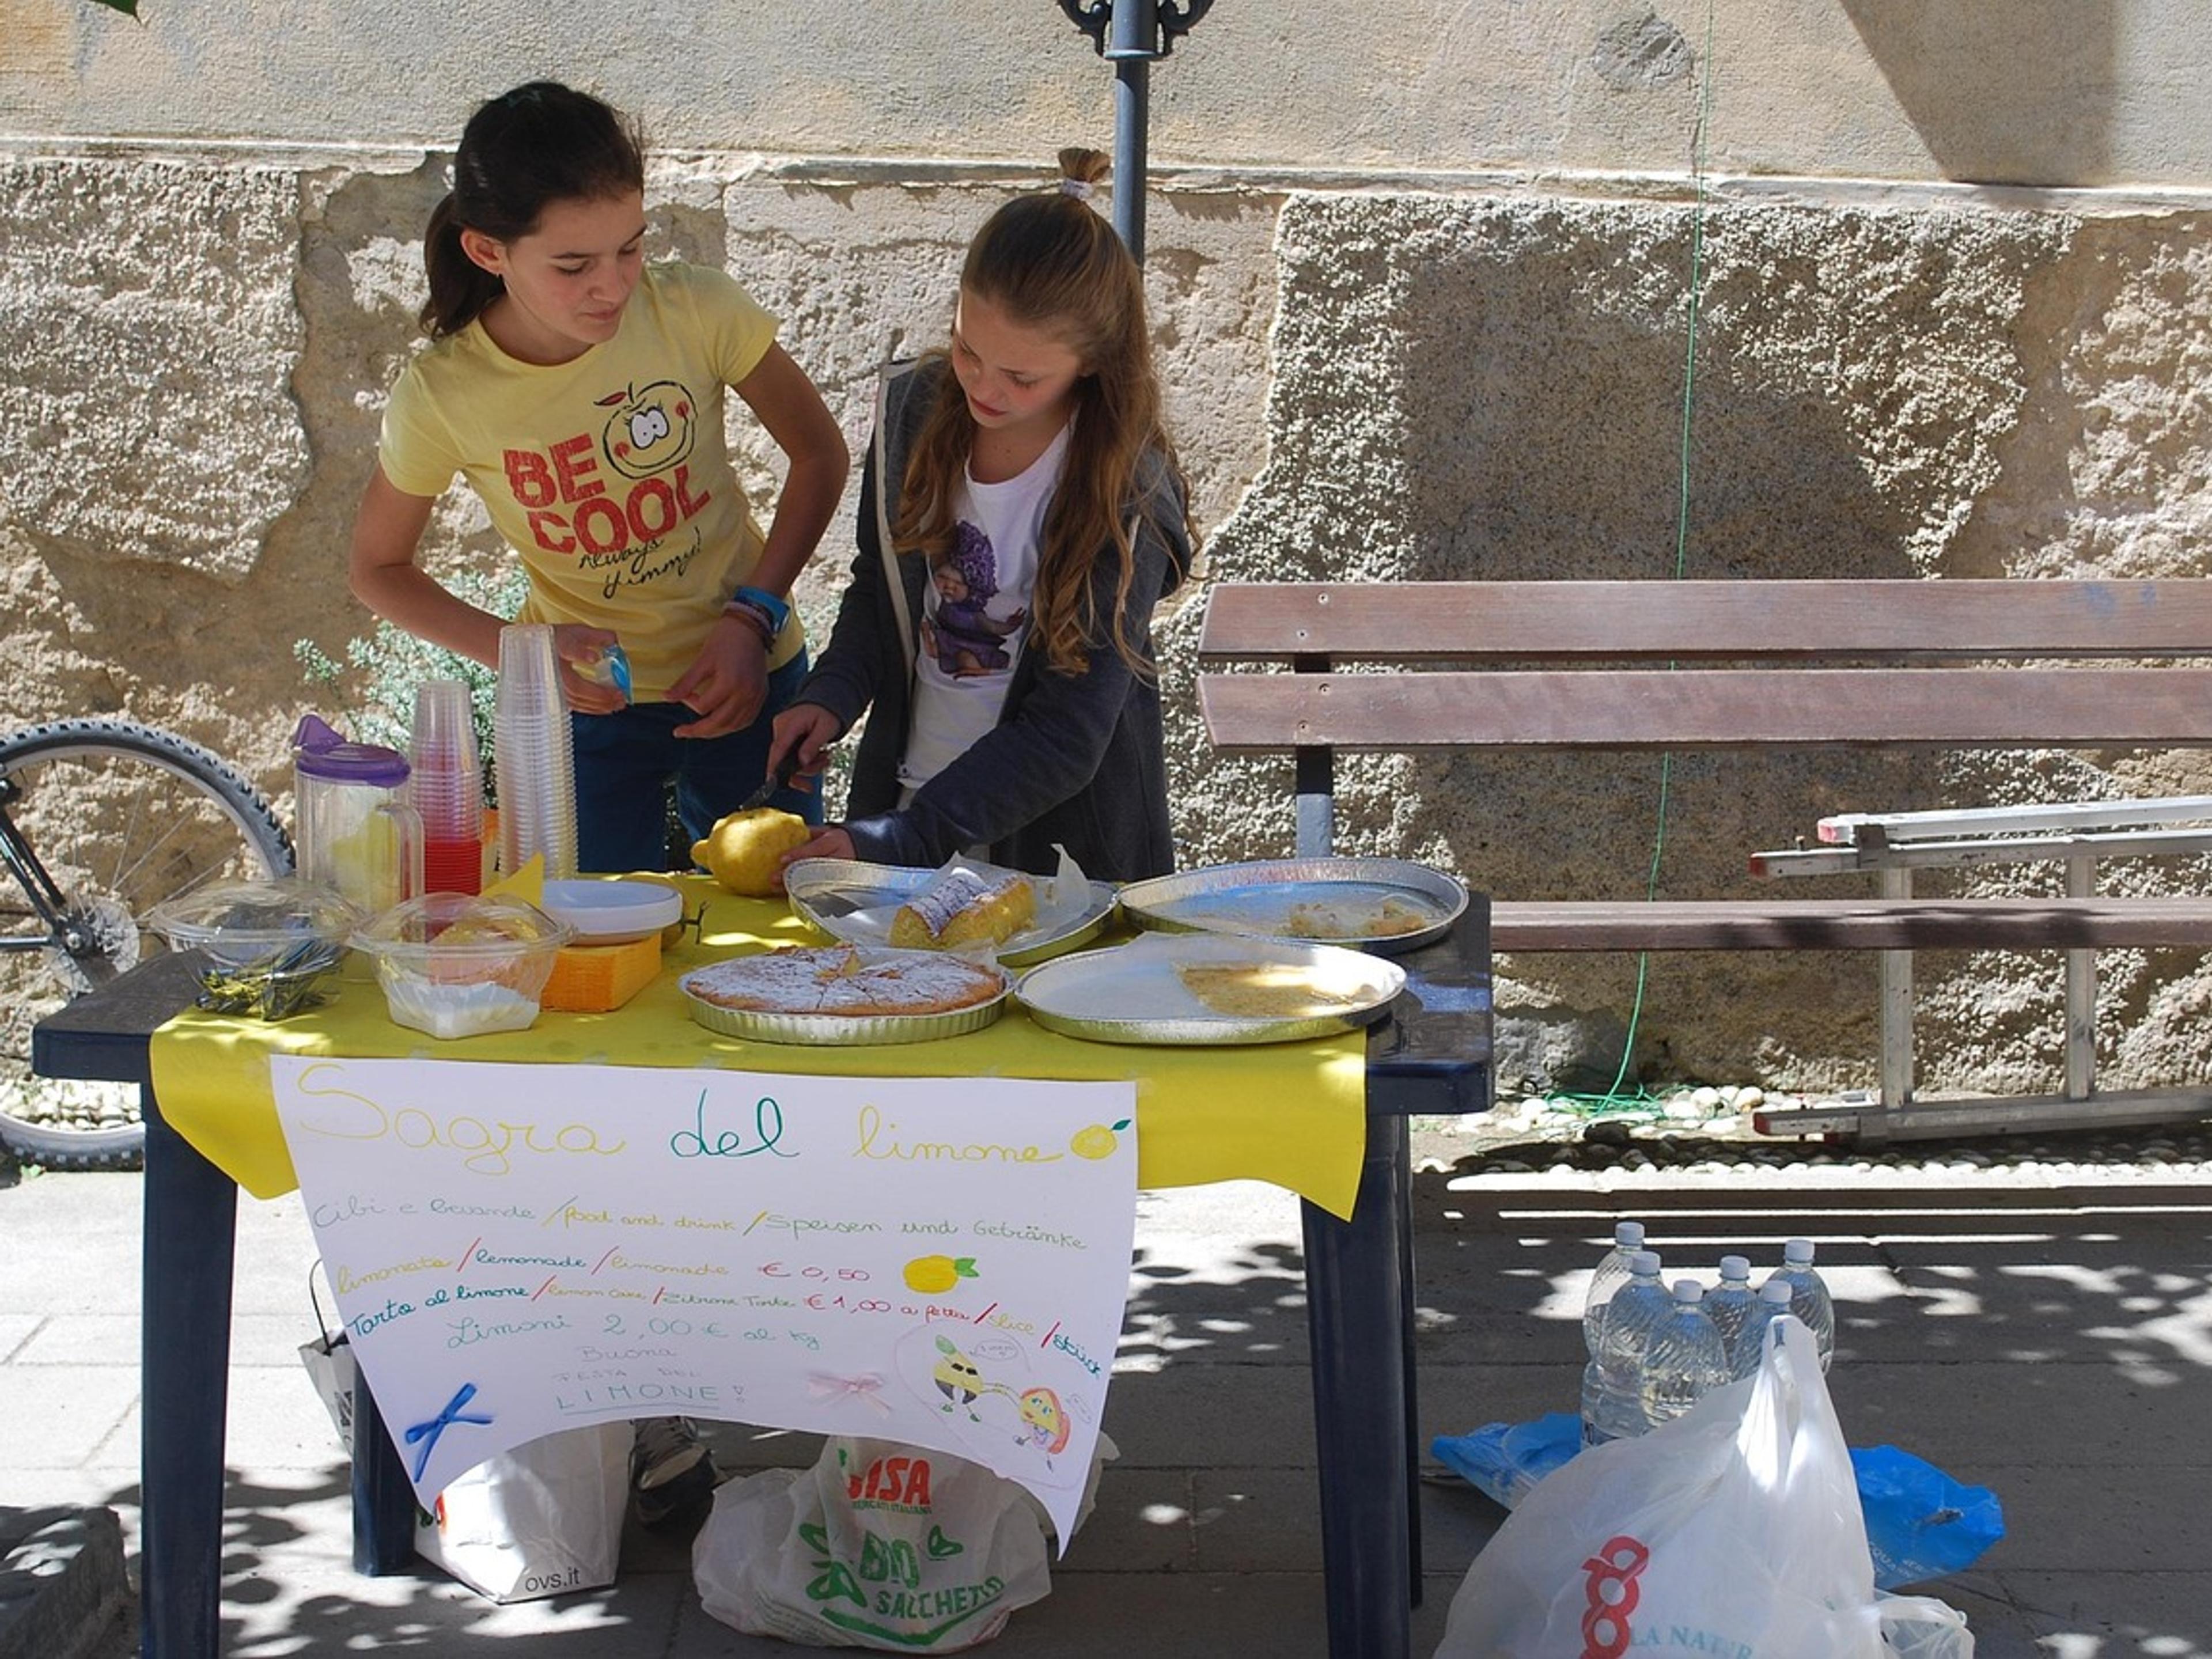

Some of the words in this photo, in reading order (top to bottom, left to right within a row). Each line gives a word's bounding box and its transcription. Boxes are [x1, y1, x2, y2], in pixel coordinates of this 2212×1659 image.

[503, 433, 605, 508] BE
[527, 464, 711, 555] COOL
[298, 1063, 626, 1175] Sagra
[670, 1088, 800, 1158] del
[851, 1104, 1065, 1164] limone
[399, 1203, 418, 1214] e
[900, 1220, 959, 1234] und
[974, 1220, 1088, 1249] Getränke
[346, 1299, 416, 1336] Torta
[425, 1289, 450, 1307] al
[447, 1315, 574, 1349] Limoni
[603, 1313, 692, 1340] 2,00
[743, 1328, 777, 1341] al
[576, 1346, 678, 1363] Buona
[525, 1566, 580, 1592] ovs.it
